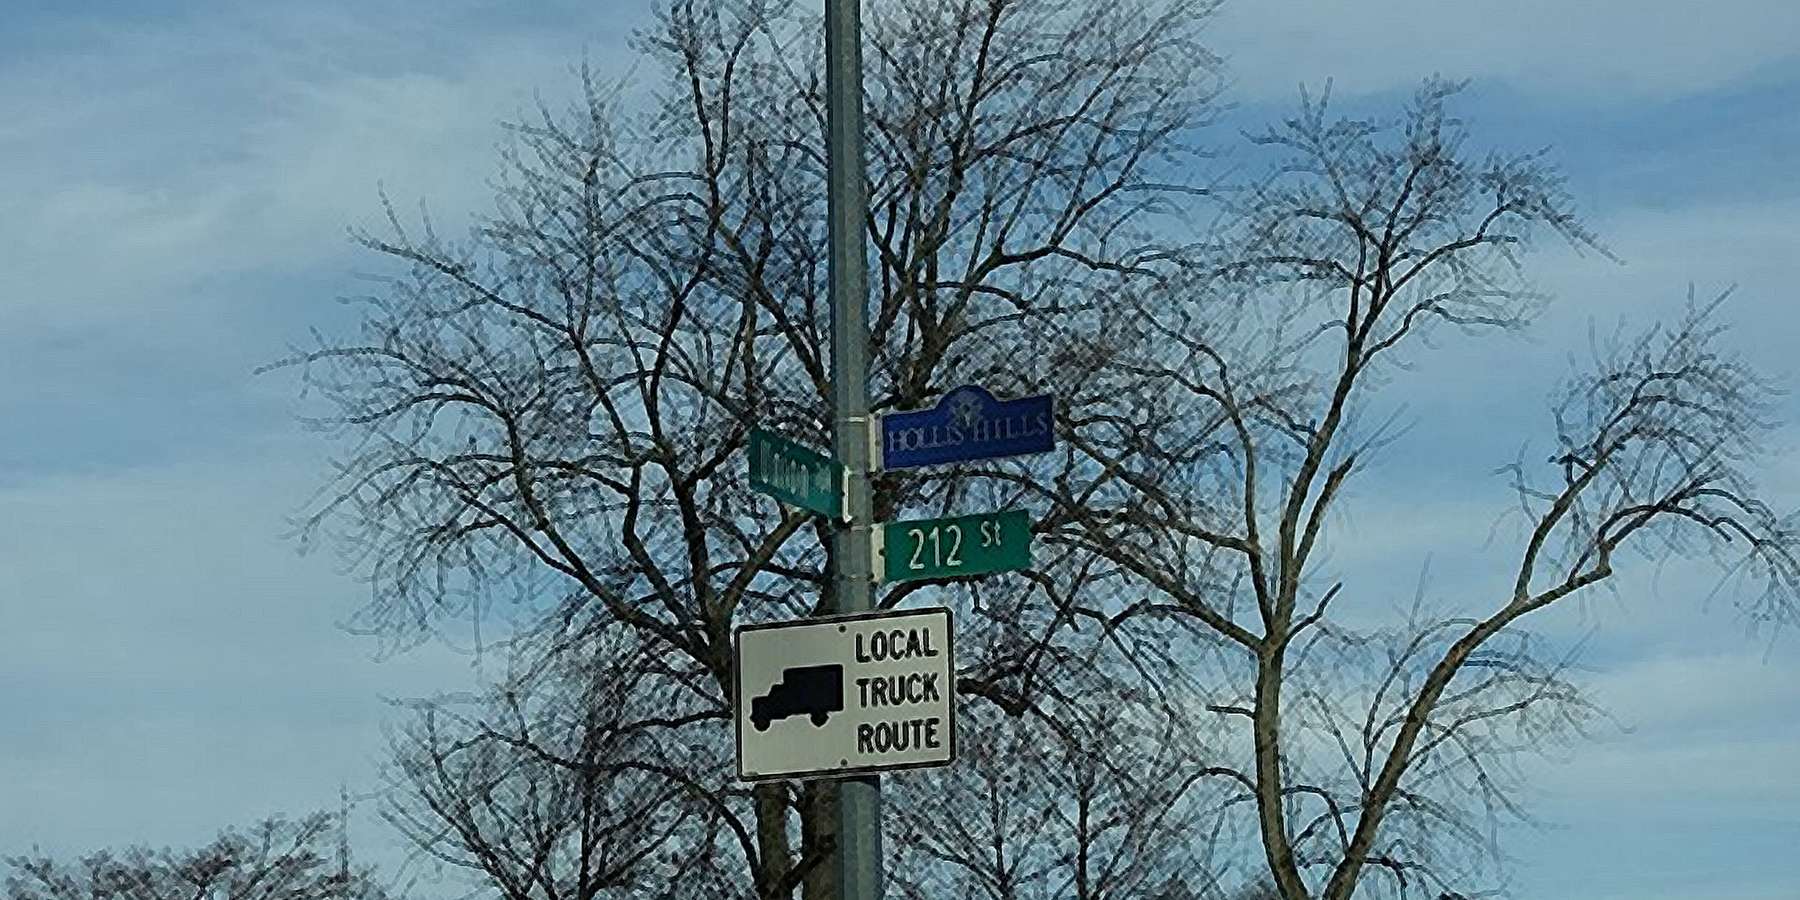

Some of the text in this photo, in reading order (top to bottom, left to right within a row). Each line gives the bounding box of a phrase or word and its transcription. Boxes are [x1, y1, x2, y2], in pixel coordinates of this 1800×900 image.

[888, 412, 1048, 453] HOLLIS HILLS
[907, 520, 1002, 570] 212 St
[855, 627, 939, 664] LOCAL
[856, 671, 940, 708] TRUCK
[857, 717, 941, 754] ROUTE
